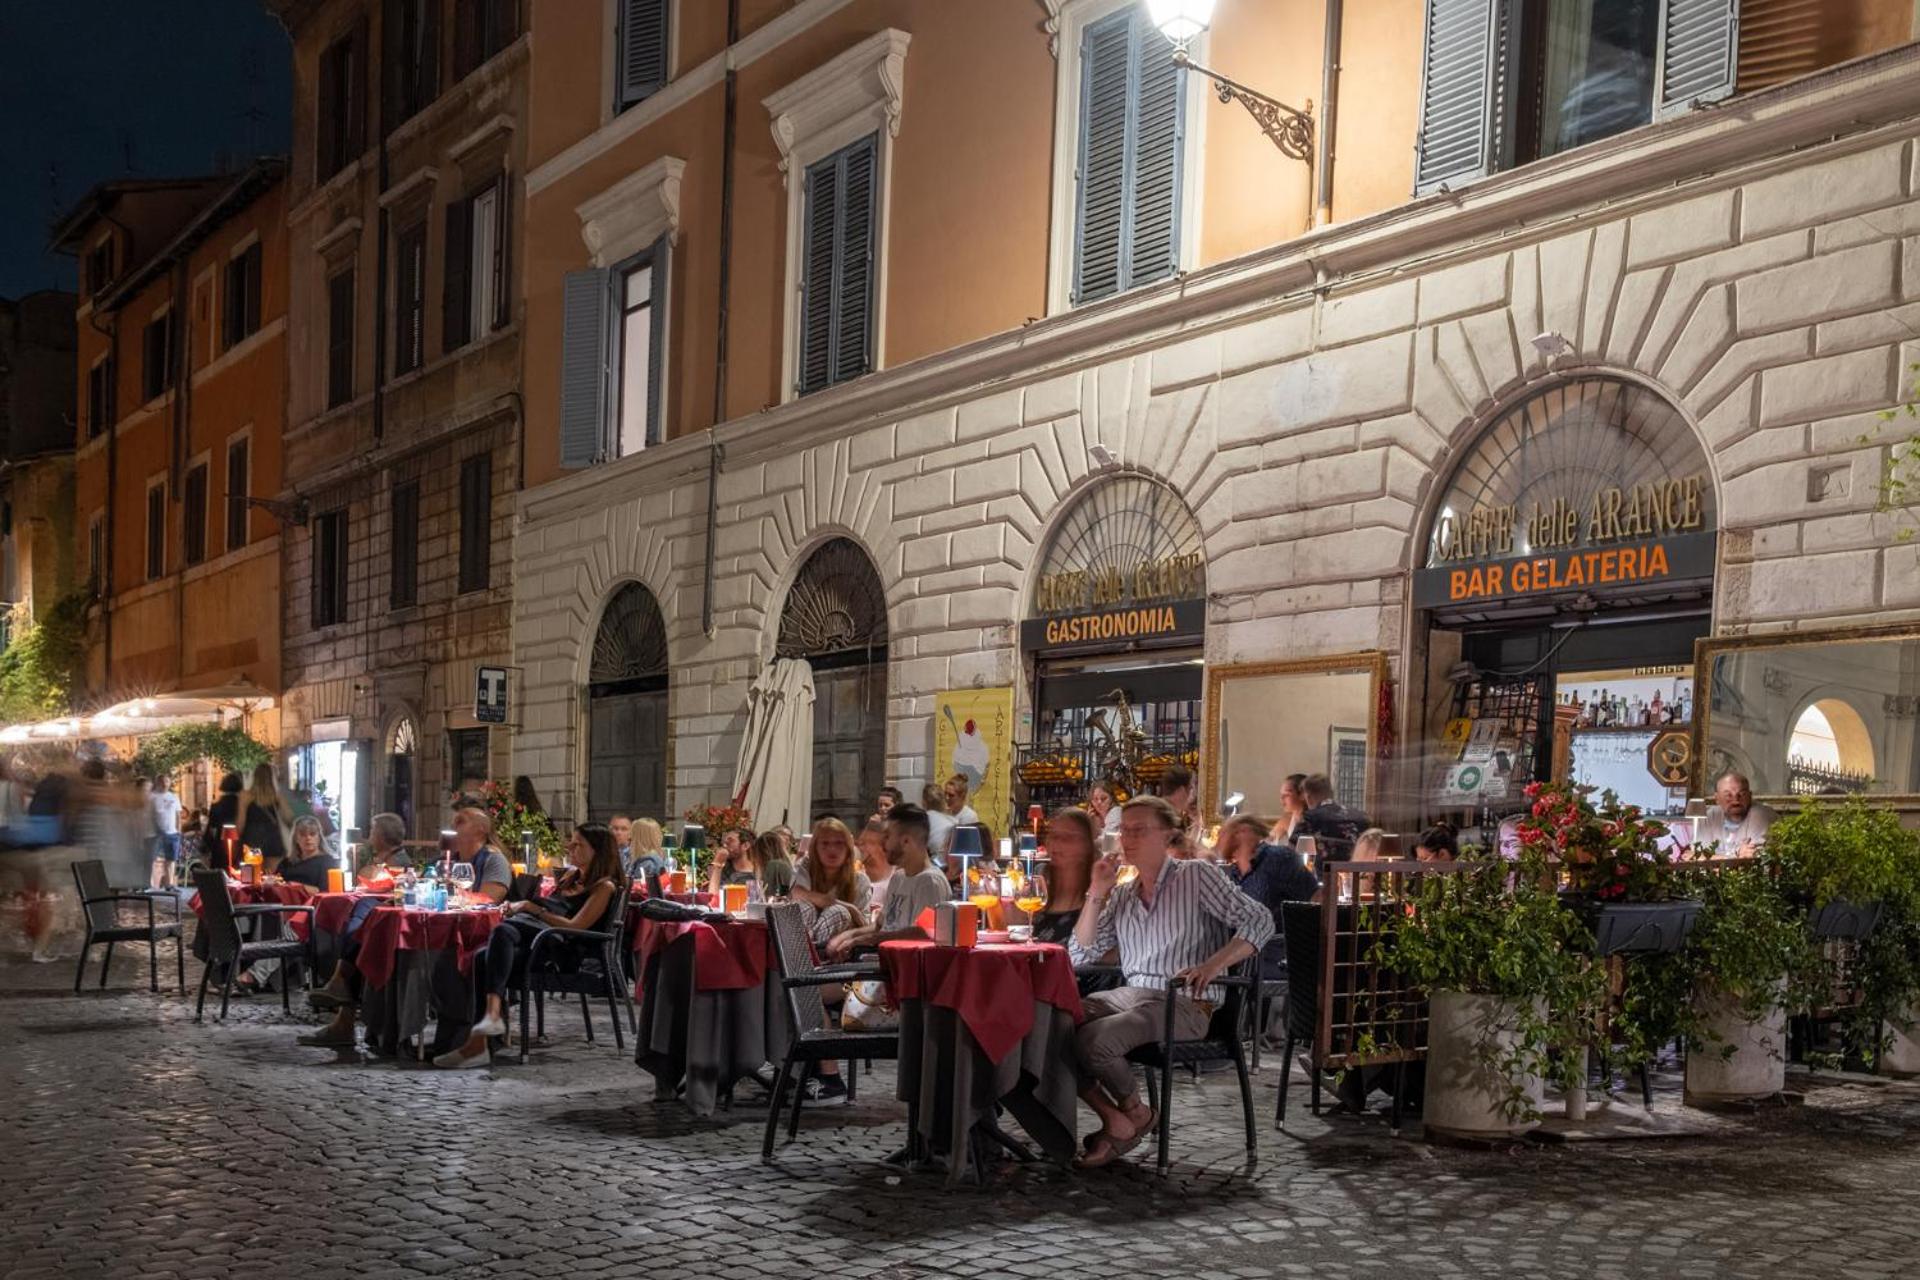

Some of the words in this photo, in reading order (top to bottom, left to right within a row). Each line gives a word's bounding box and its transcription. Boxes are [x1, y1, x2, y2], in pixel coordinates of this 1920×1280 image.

[1527, 496, 1579, 548] delle
[1585, 476, 1703, 539] ARANCE
[1450, 564, 1504, 601] BAR
[1511, 544, 1669, 593] GELATERIA
[1046, 606, 1176, 645] GASTRONOMIA
[482, 670, 504, 705] T
